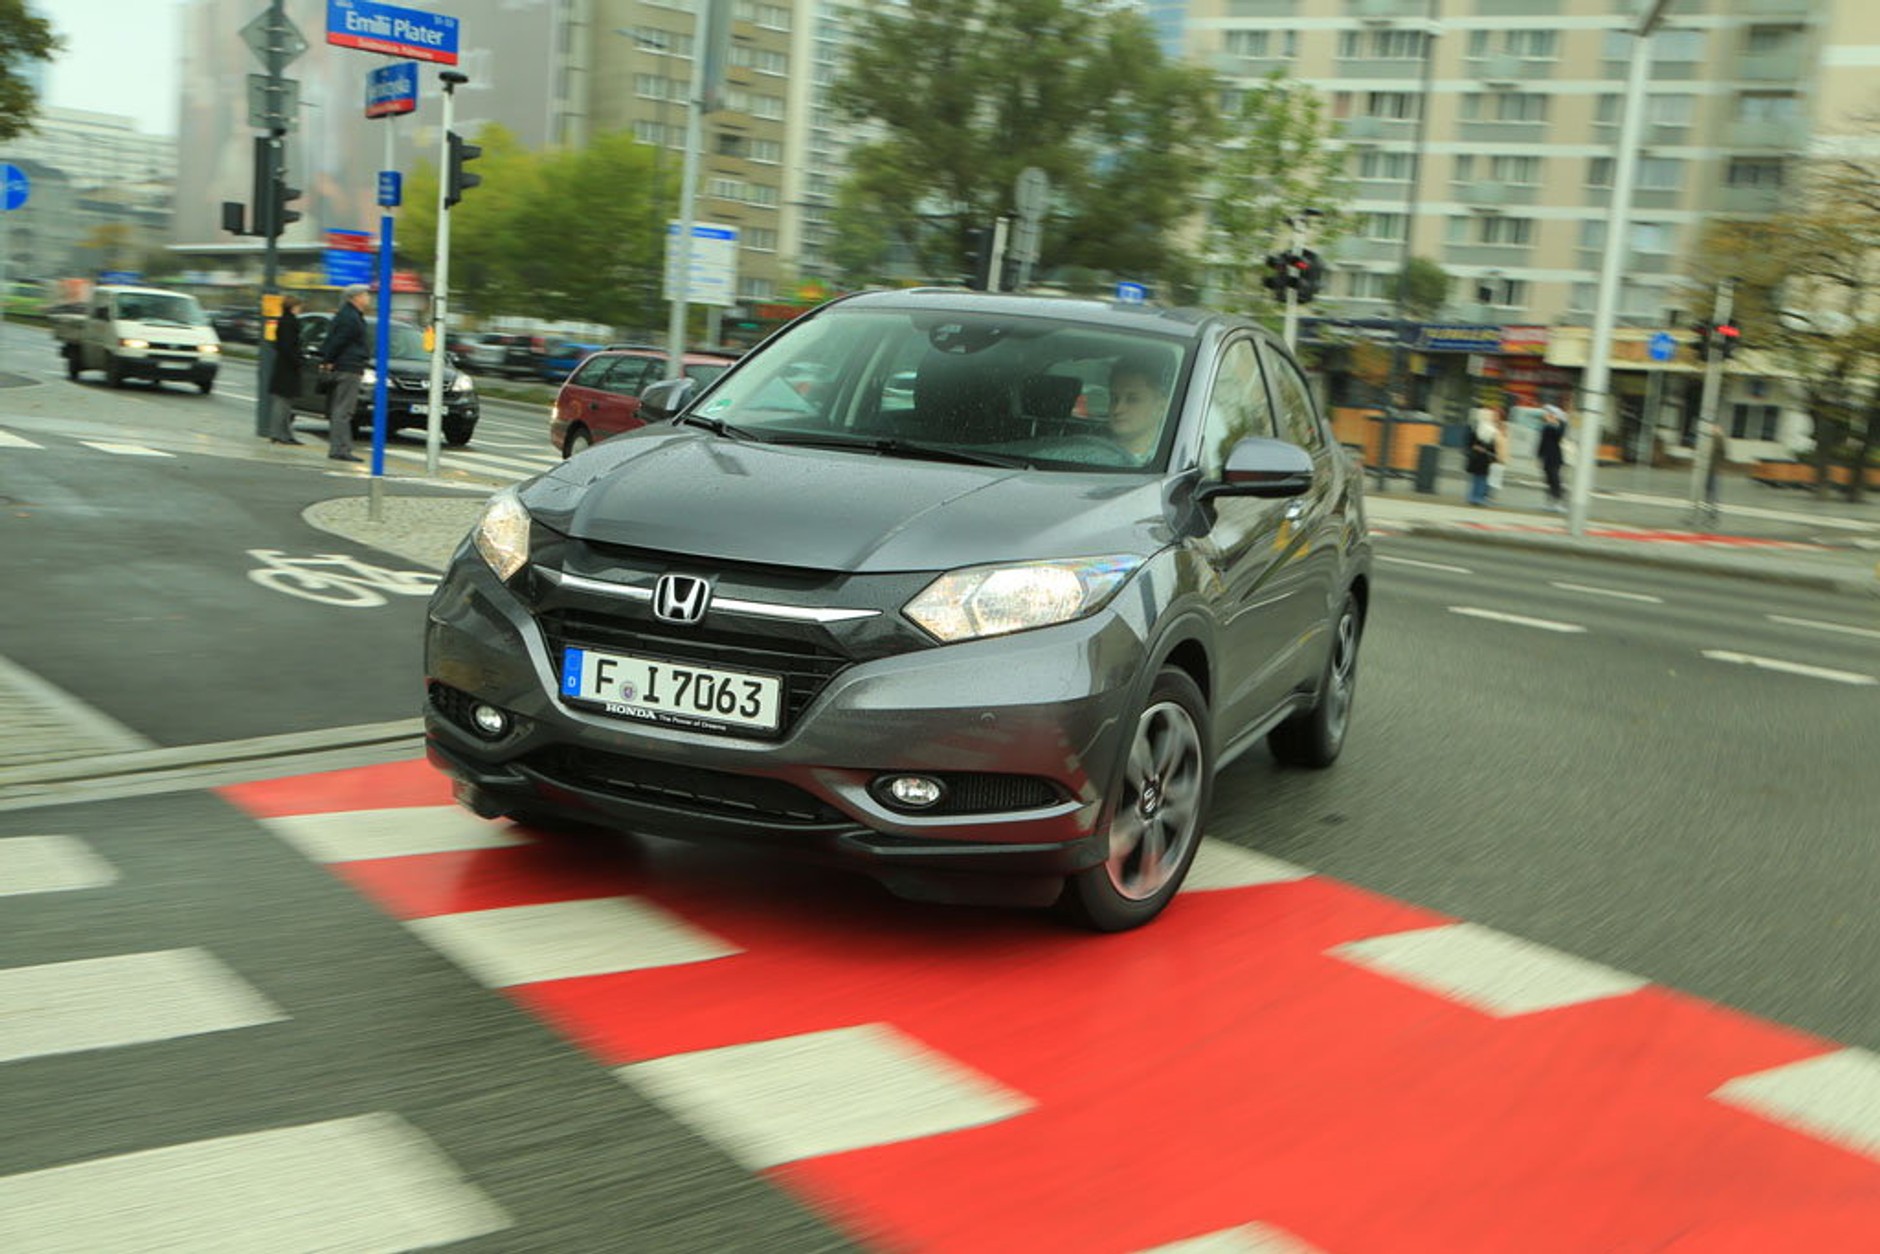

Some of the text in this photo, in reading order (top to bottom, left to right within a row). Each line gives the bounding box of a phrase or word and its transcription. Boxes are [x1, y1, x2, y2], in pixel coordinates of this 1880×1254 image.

[394, 18, 444, 46] Plater
[595, 659, 618, 694] F
[672, 669, 762, 718] 7063
[605, 702, 657, 720] HONDA
